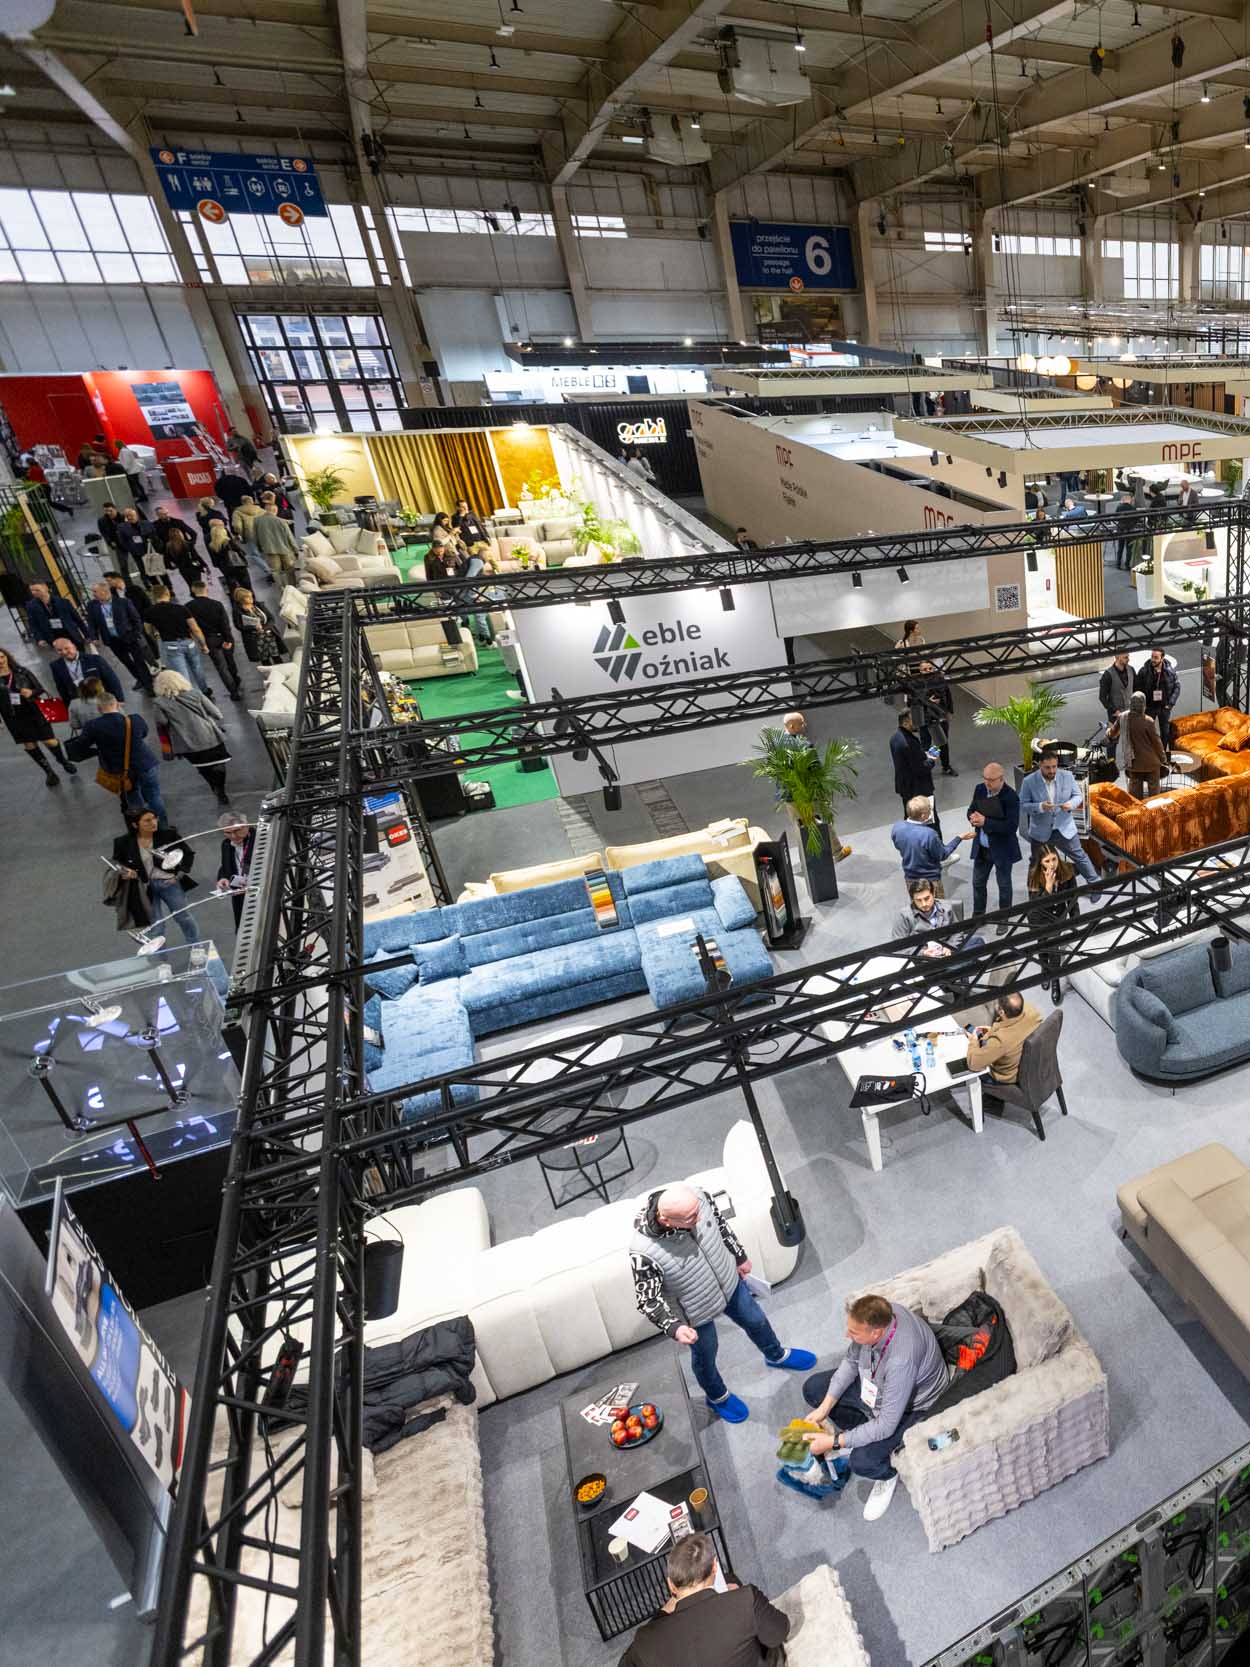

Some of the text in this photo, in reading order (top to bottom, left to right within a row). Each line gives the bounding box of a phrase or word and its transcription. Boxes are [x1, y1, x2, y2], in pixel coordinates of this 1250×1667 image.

[177, 153, 187, 164] F
[280, 159, 292, 170] E
[752, 245, 762, 253] do
[805, 235, 832, 276] 6
[552, 376, 590, 388] MEBLE
[1162, 442, 1202, 462] MPF
